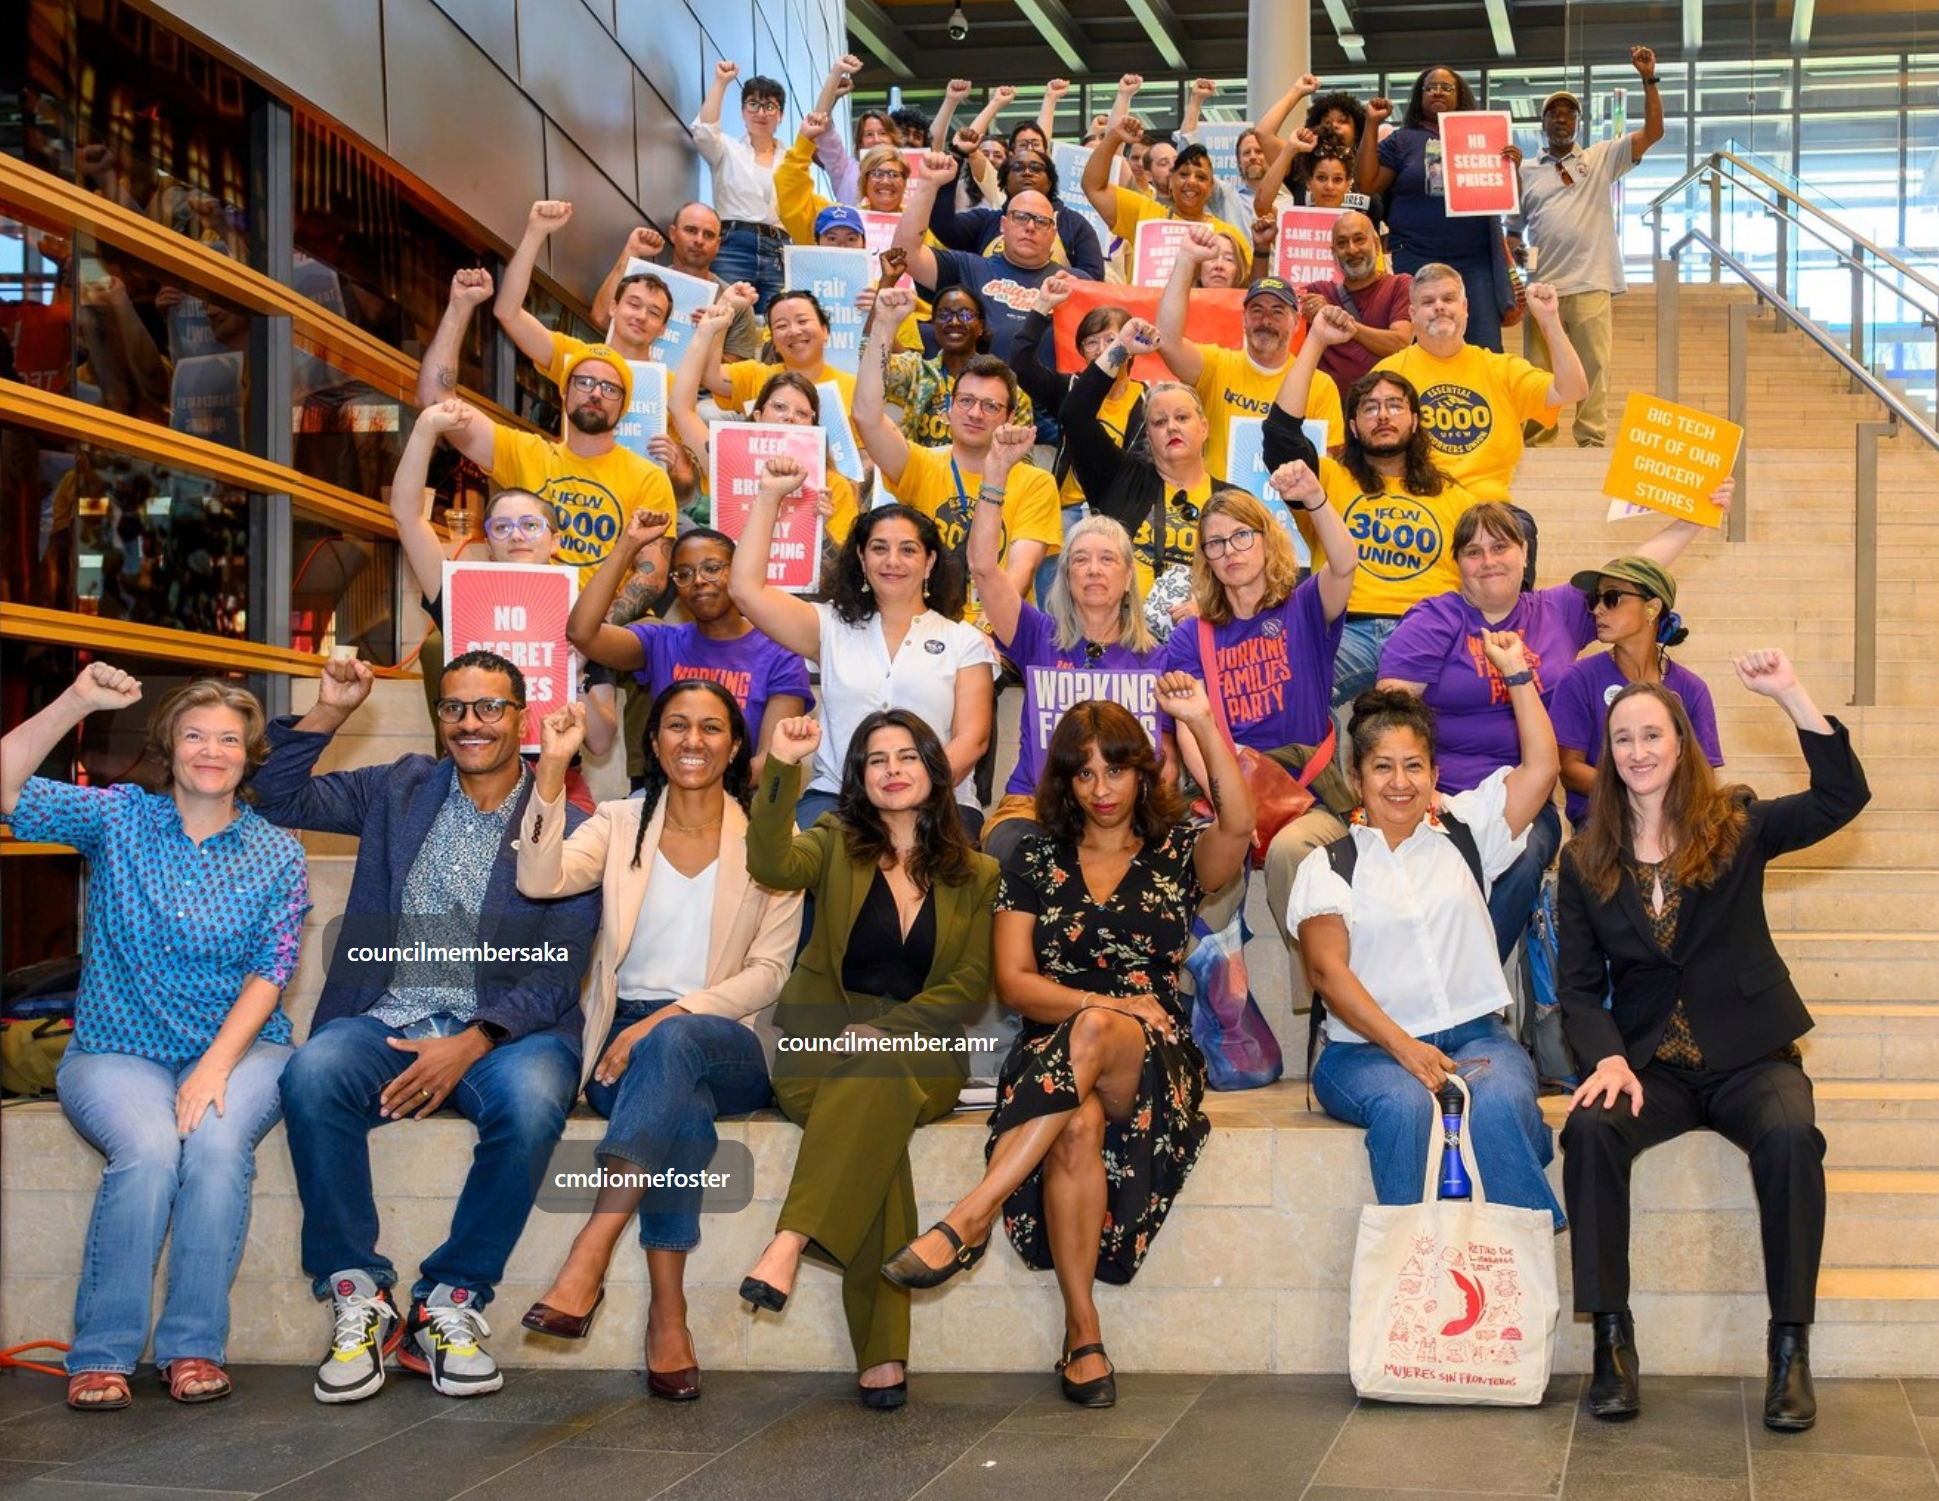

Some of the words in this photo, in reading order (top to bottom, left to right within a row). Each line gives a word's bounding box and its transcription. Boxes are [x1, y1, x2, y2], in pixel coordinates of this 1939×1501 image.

[1467, 134, 1486, 149] NO
[1453, 154, 1502, 169] SECRET
[1456, 172, 1504, 187] PRICES
[1285, 227, 1313, 241] SAME
[1314, 230, 1332, 243] STO
[1286, 246, 1314, 260] SAME
[1290, 265, 1334, 283] SAME
[1426, 385, 1472, 399] ESSENTIAL
[1419, 404, 1491, 431] 3000
[1647, 406, 1674, 427] BIG
[1677, 415, 1717, 442] TECH
[748, 436, 787, 455] KEEP
[1629, 427, 1663, 449] OUT
[1665, 438, 1687, 457] OF
[1689, 446, 1721, 470] OUR
[1633, 454, 1706, 490] GROCERY
[1634, 481, 1695, 514] STORES
[554, 505, 616, 542] 000
[1348, 513, 1437, 554] 3000
[1357, 543, 1422, 570] UNION
[493, 605, 528, 632] NO
[1033, 669, 1157, 713] WORKING
[1226, 682, 1285, 726] PARTY
[1384, 1363, 1436, 1380] MUJERES
[1439, 1371, 1457, 1384] SIN
